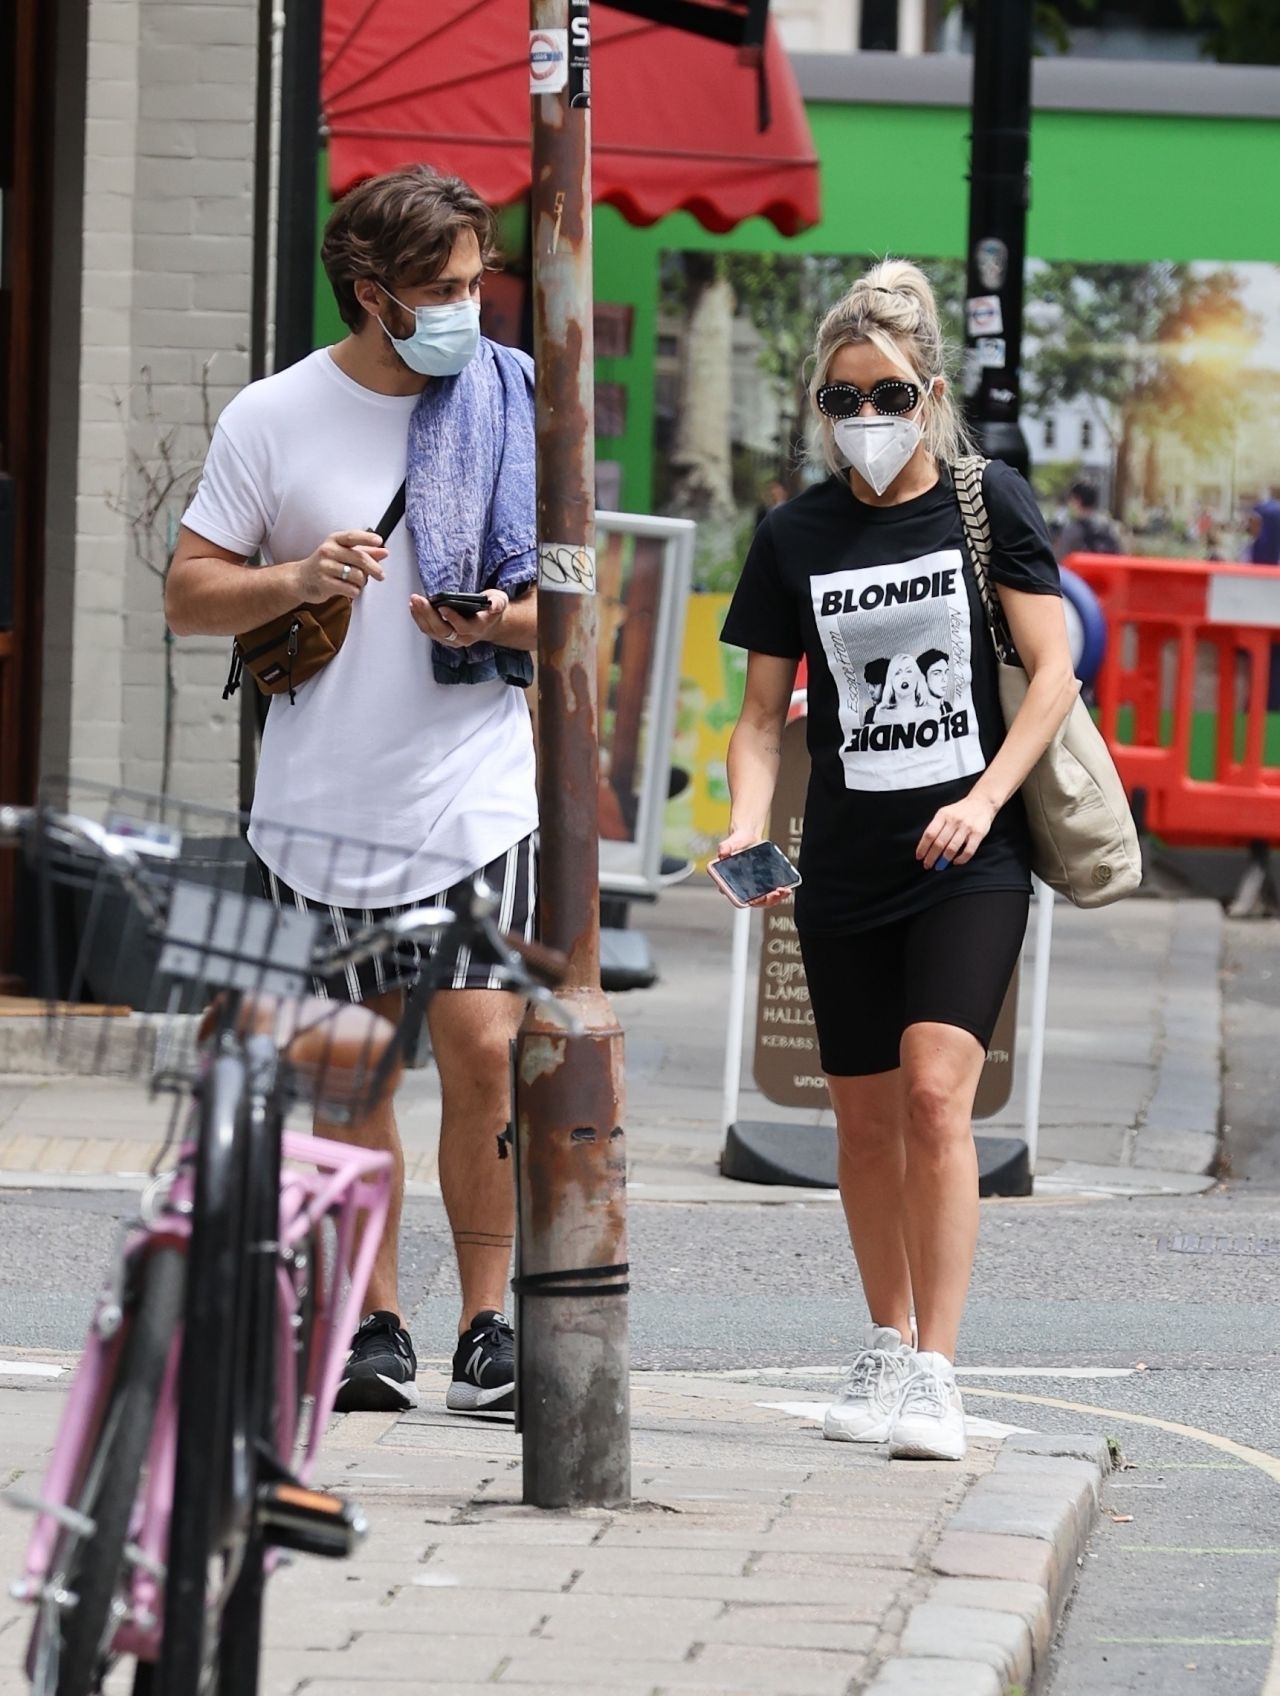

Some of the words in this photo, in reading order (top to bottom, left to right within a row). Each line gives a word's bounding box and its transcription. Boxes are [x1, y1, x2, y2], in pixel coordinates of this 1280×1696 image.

[820, 568, 957, 617] BLONDIE
[844, 709, 969, 753] BLONDIE
[765, 983, 810, 1002] LAMB
[761, 1034, 814, 1050] KEBABS
